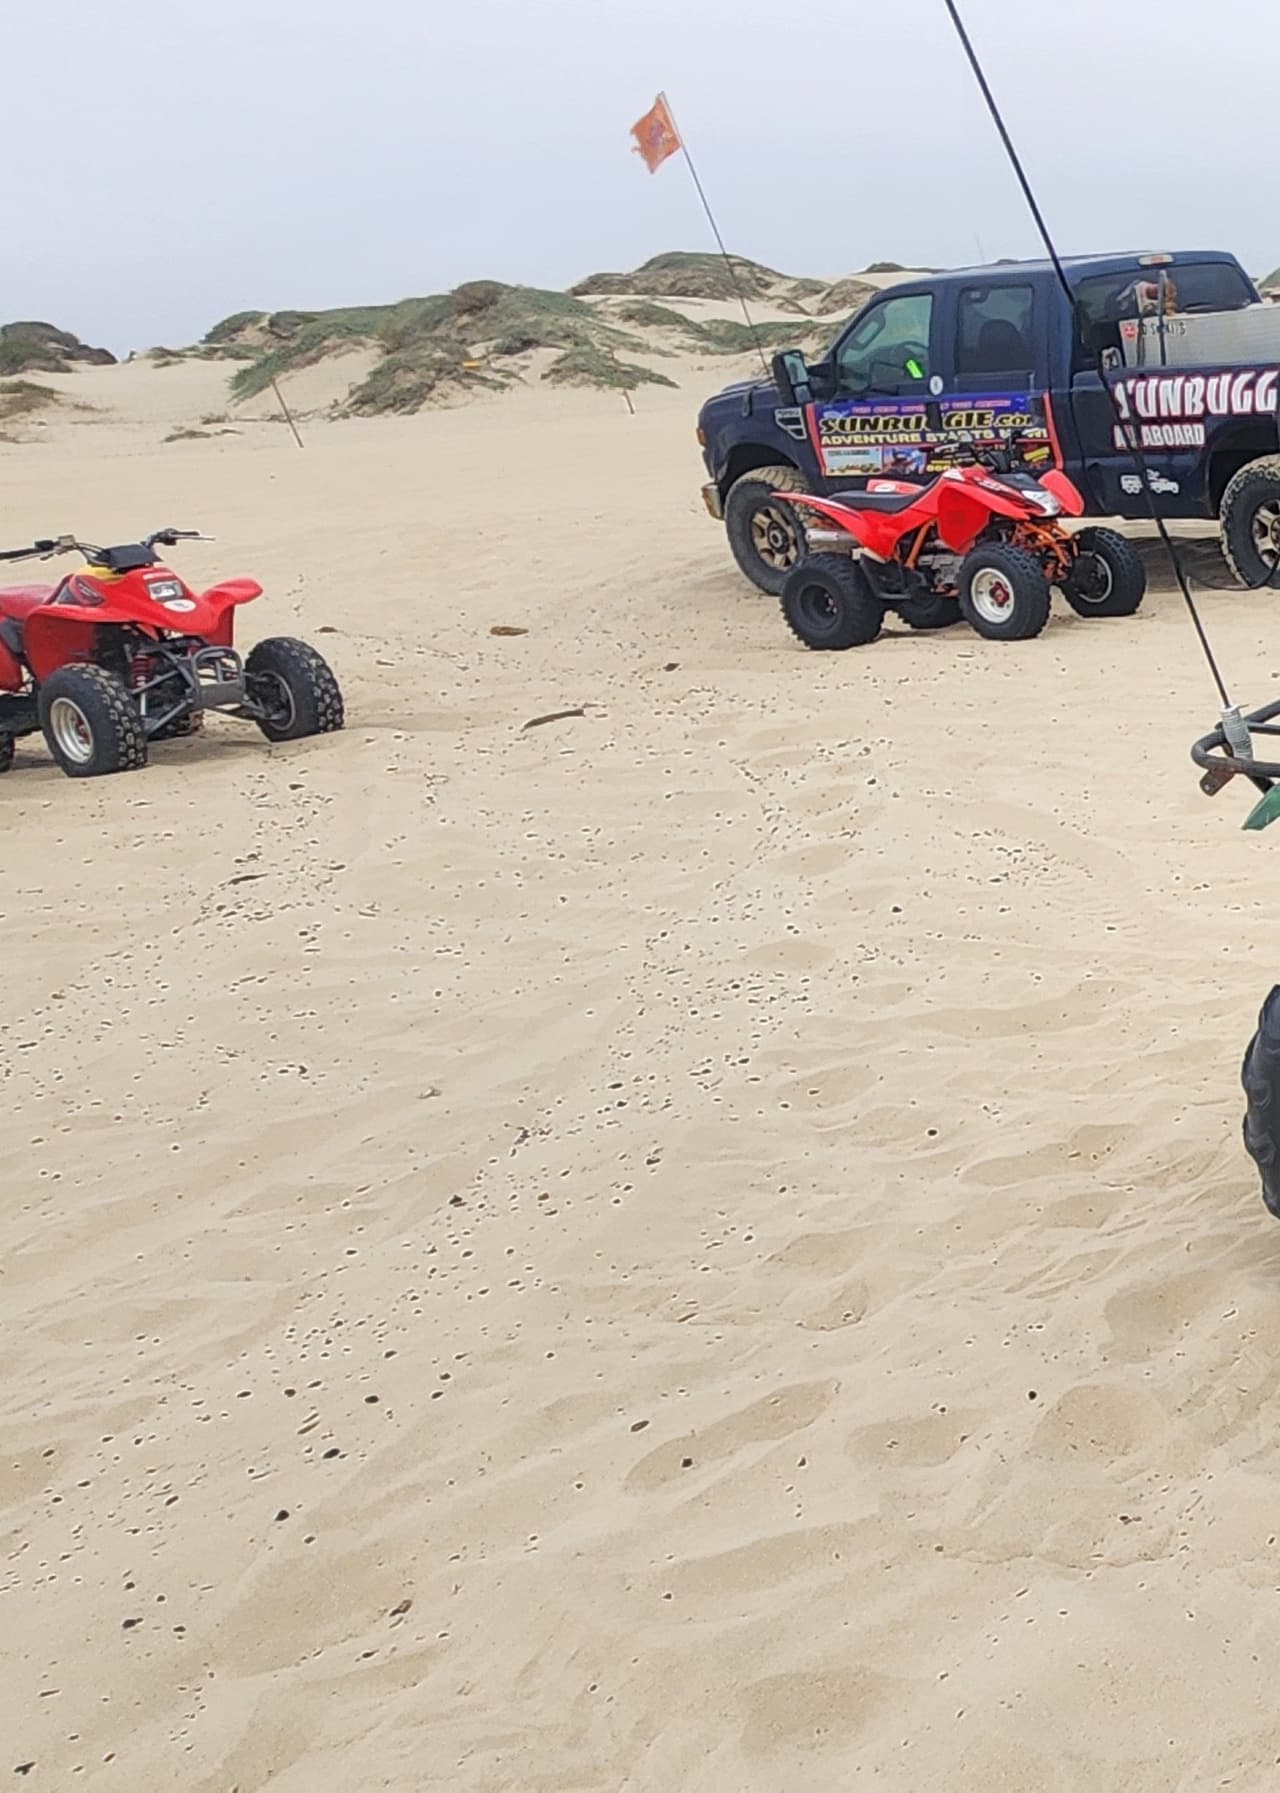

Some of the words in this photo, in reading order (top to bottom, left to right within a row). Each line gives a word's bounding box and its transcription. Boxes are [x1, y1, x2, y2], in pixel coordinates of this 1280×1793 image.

[821, 432, 921, 445] ADVENTURE
[925, 429, 996, 442] STATS
[1141, 424, 1205, 446] ABOARD
